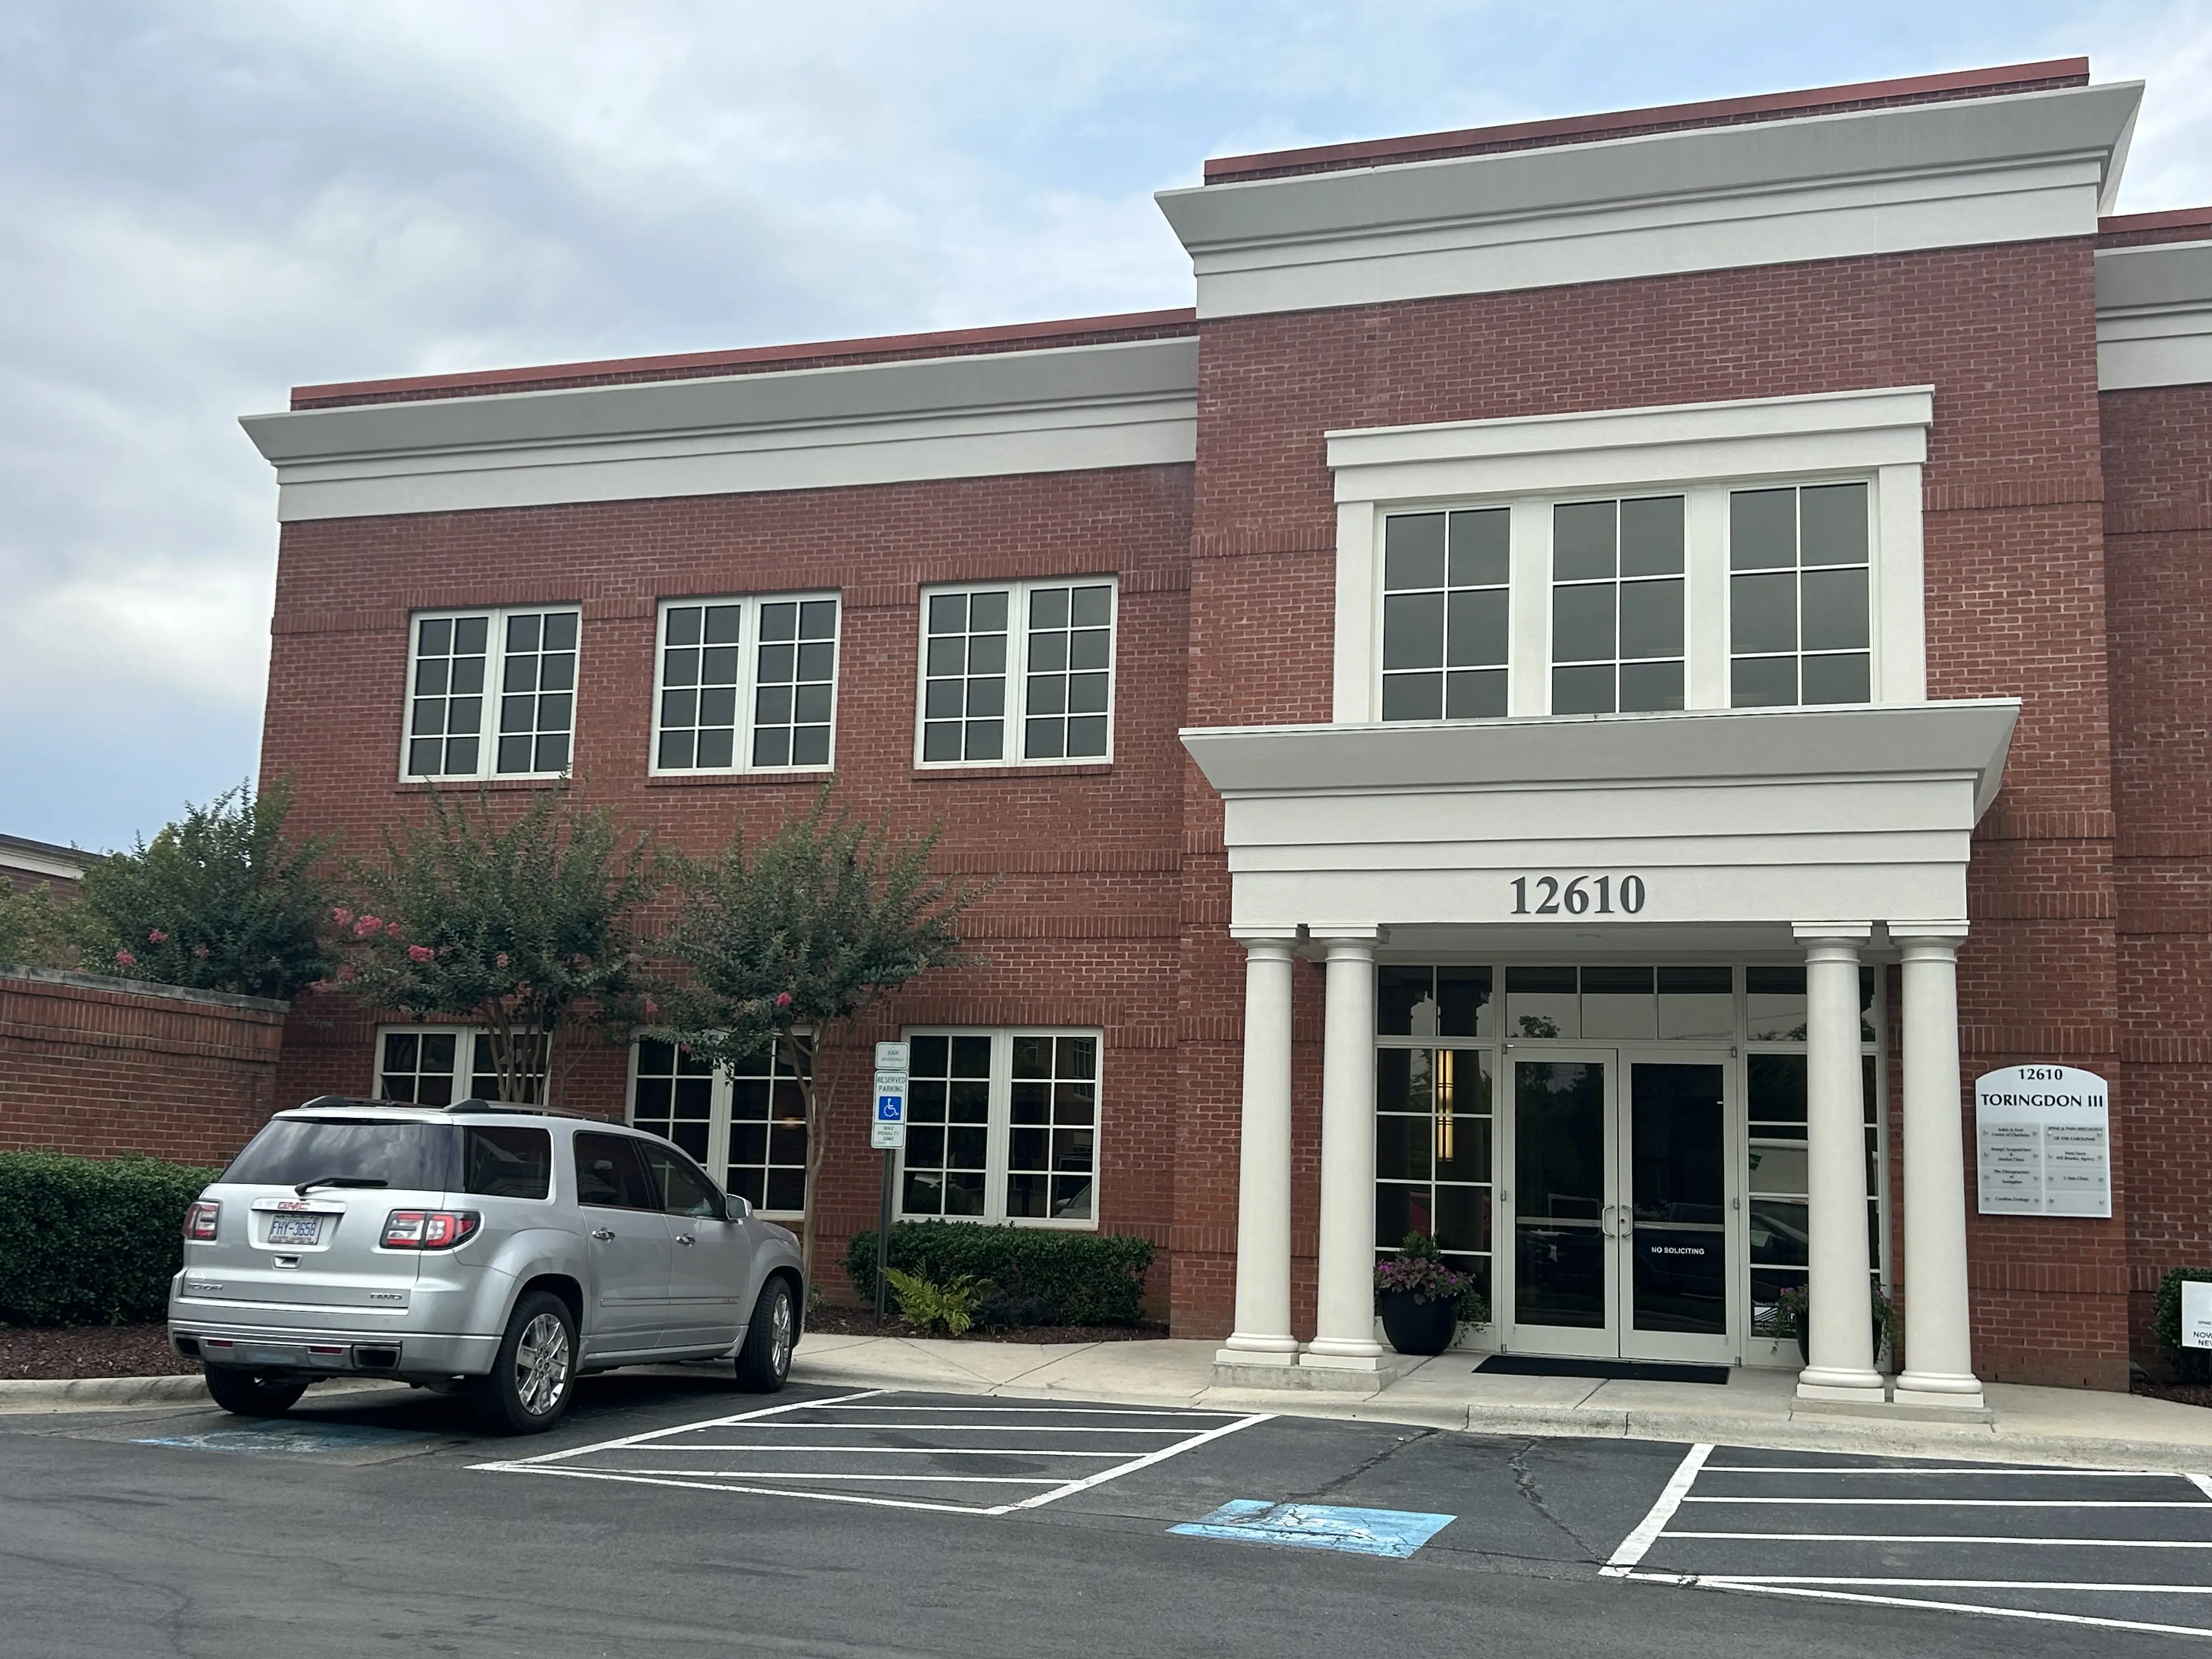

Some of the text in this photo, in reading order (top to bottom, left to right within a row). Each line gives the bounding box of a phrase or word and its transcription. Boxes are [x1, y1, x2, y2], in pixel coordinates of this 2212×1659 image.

[1510, 875, 1645, 914] 12610
[2018, 1069, 2063, 1080] 12610
[1980, 1094, 2103, 1107] TORINGDON III
[277, 1201, 311, 1210] GMC
[271, 1221, 317, 1236] FHY-3658
[1664, 1247, 1705, 1255] SOLICITING
